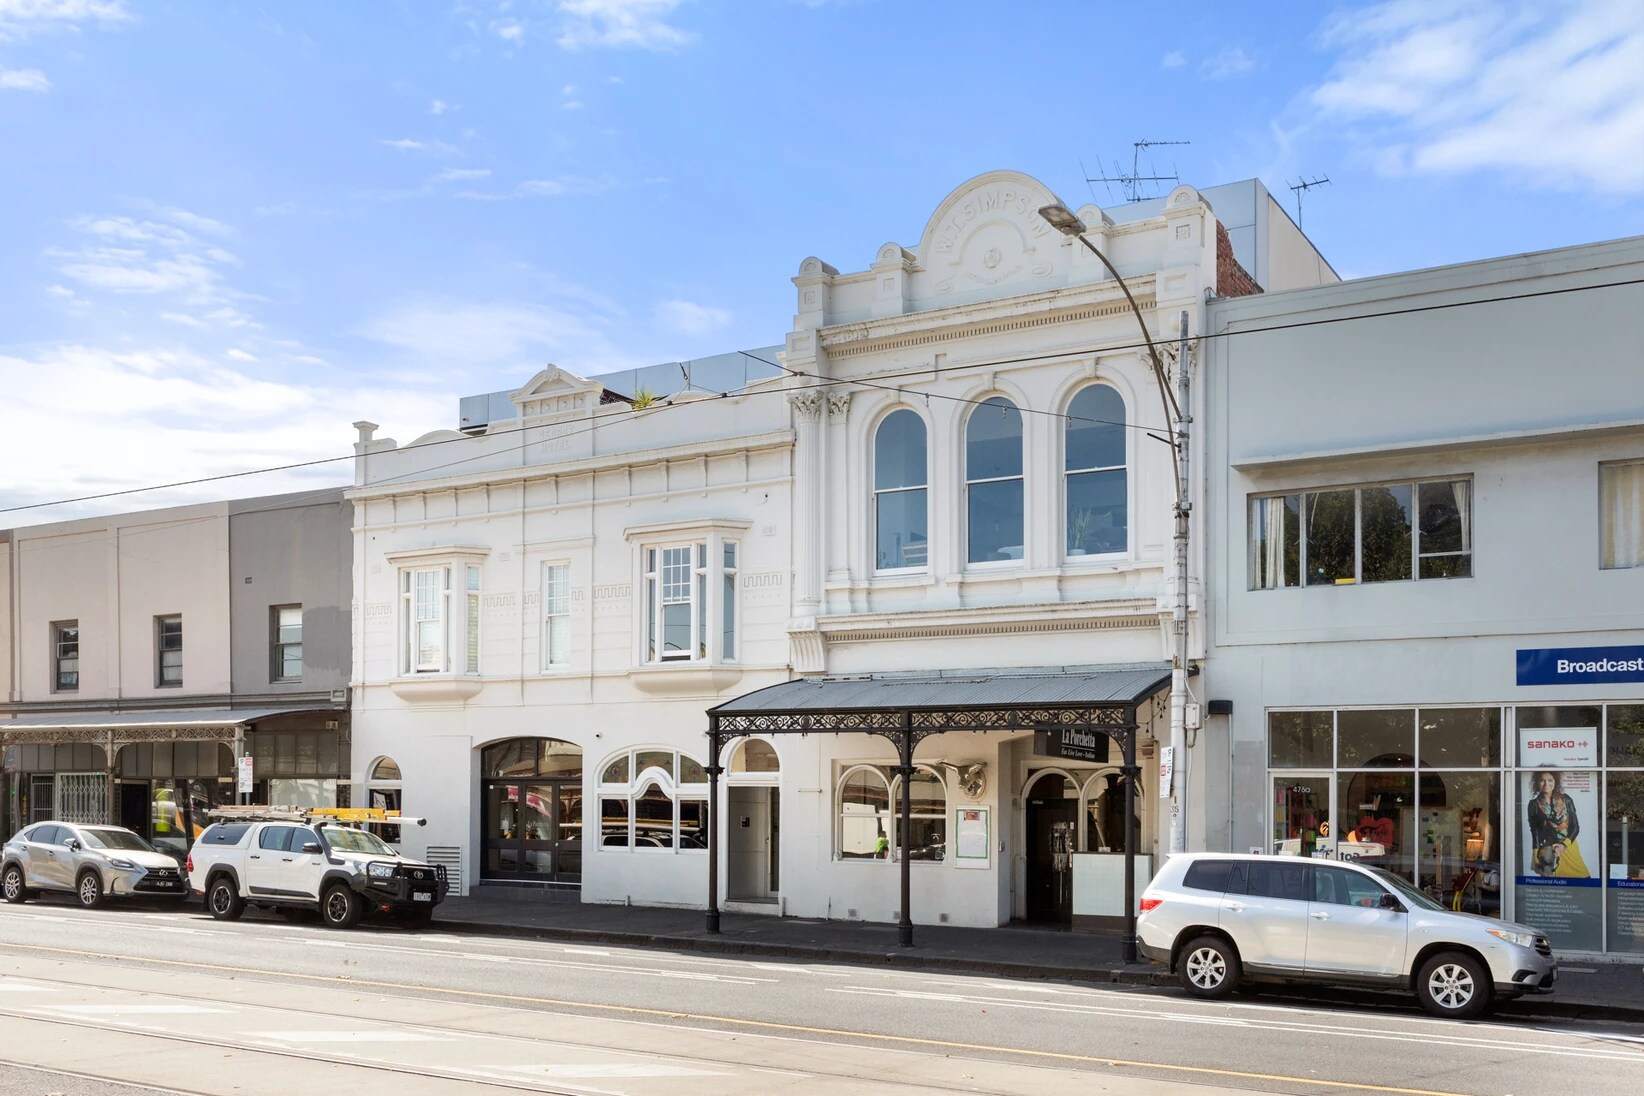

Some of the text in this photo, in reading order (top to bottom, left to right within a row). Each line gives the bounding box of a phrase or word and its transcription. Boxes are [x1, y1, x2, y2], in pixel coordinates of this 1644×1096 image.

[1557, 658, 1644, 674] Broadcast
[1062, 729, 1095, 748] La Porchetta
[1527, 740, 1575, 749] sanako
[1525, 877, 1552, 885] Professional
